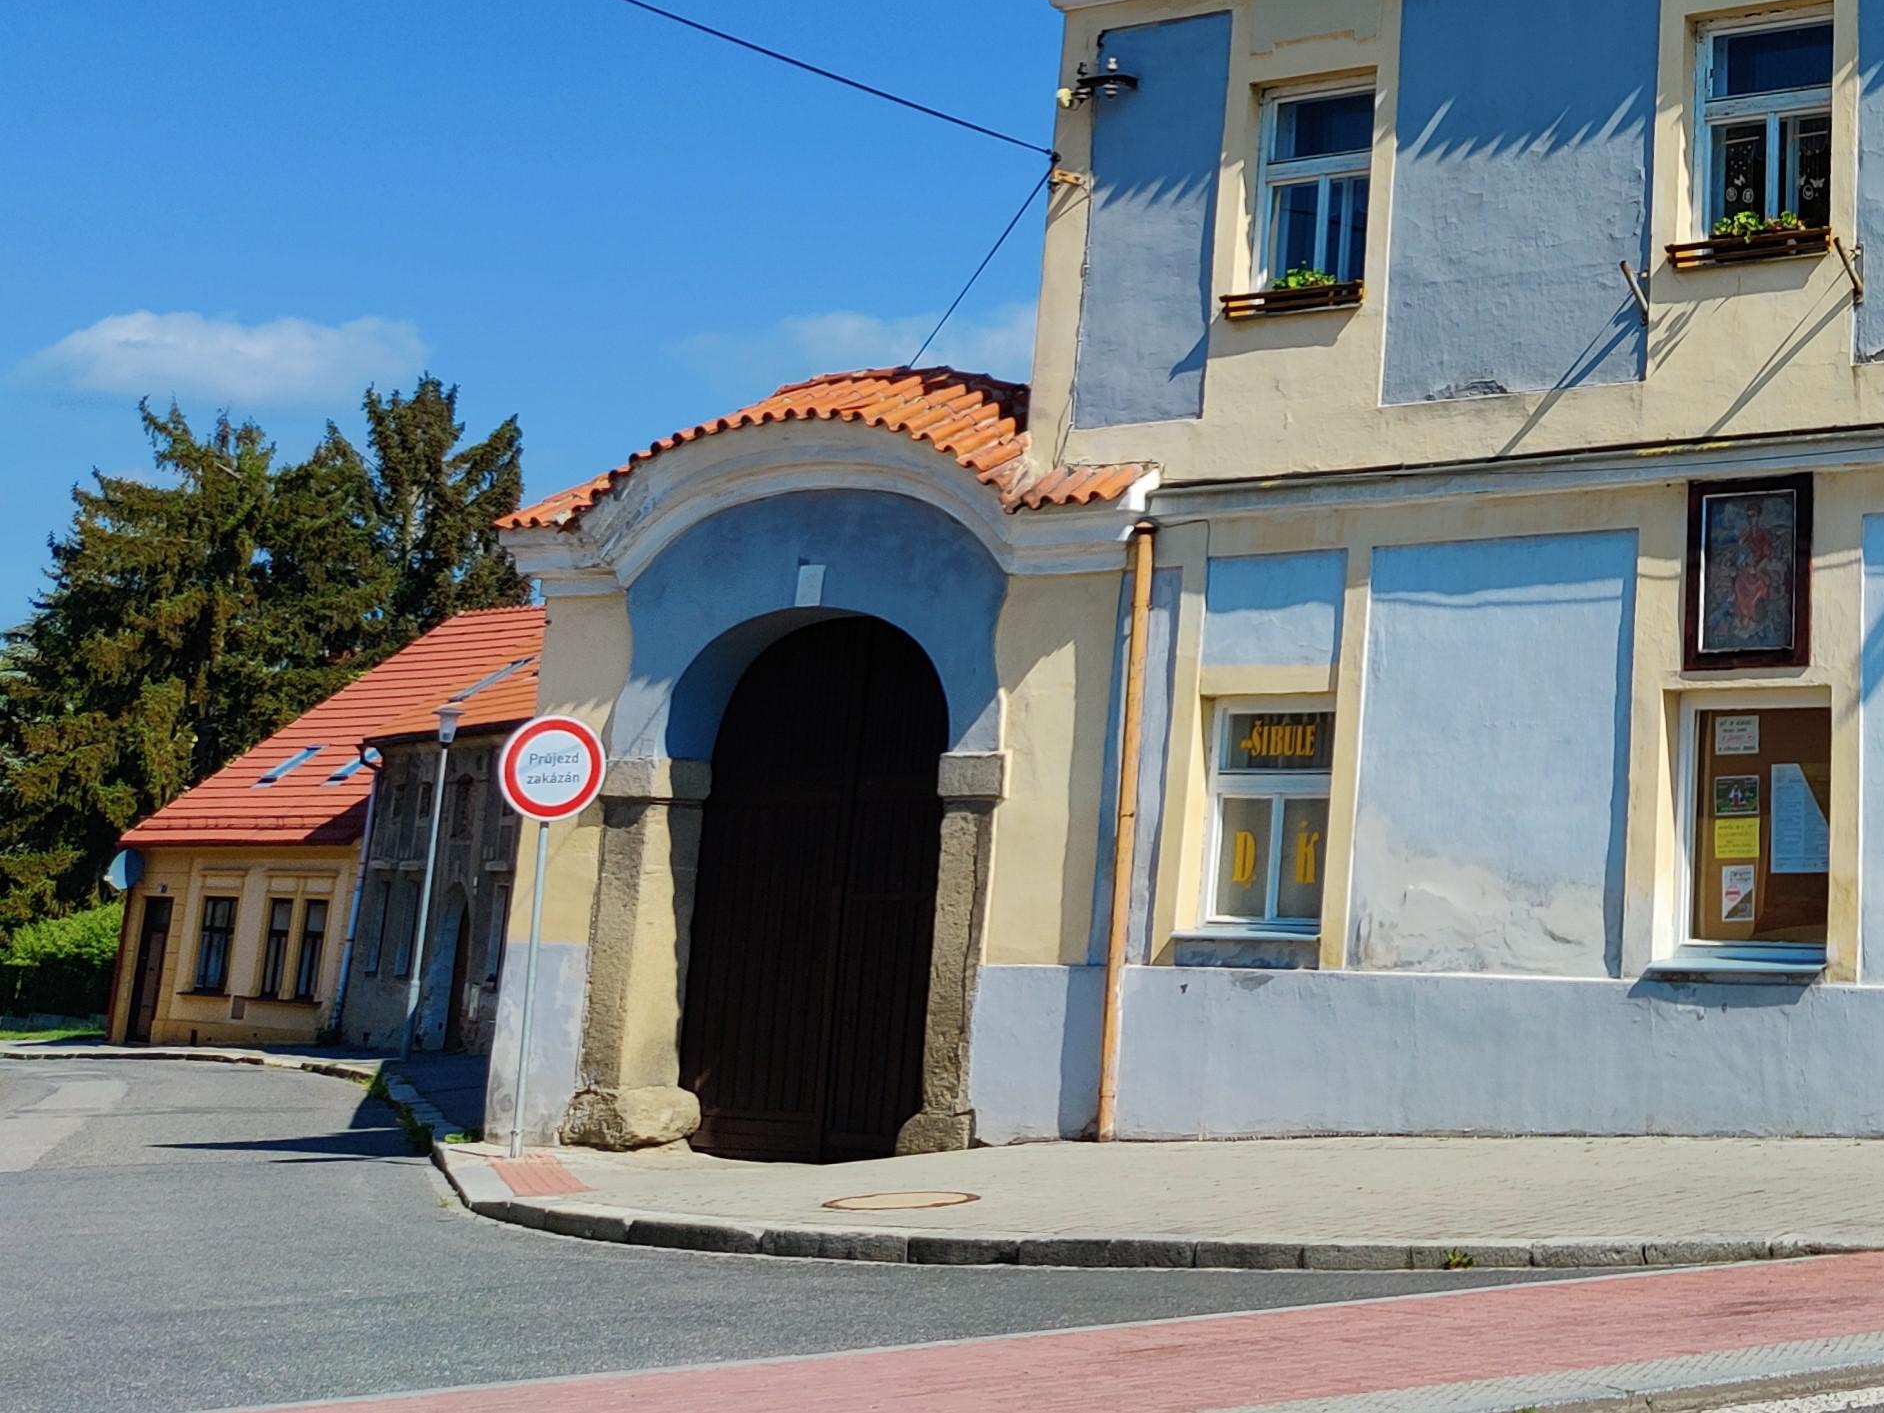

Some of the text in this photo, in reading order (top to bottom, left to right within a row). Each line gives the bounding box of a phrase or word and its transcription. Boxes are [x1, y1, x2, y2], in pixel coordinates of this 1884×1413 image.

[1250, 720, 1316, 757] ŠIBULE
[528, 751, 580, 768] Průjezd
[526, 771, 580, 785] zakázán
